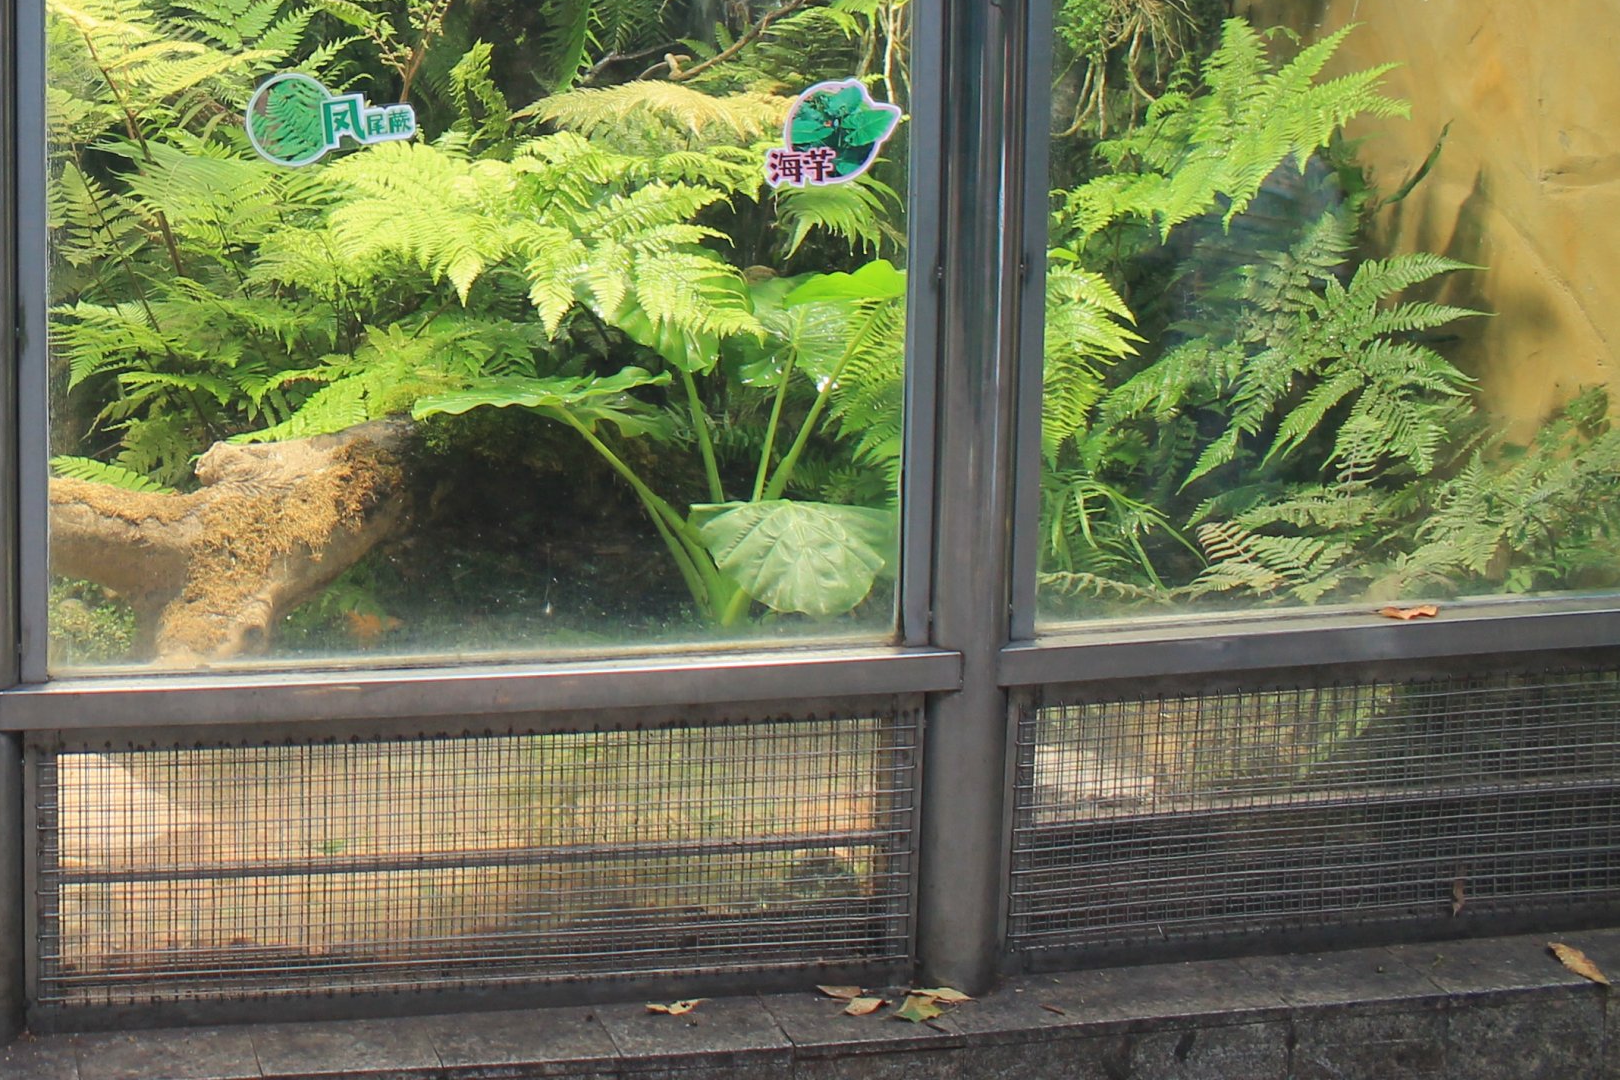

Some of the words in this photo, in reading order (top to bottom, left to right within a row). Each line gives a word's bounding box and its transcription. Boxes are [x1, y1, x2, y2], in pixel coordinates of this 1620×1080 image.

[323, 99, 412, 144] 凤尾蕨
[770, 150, 834, 182] 海芋
